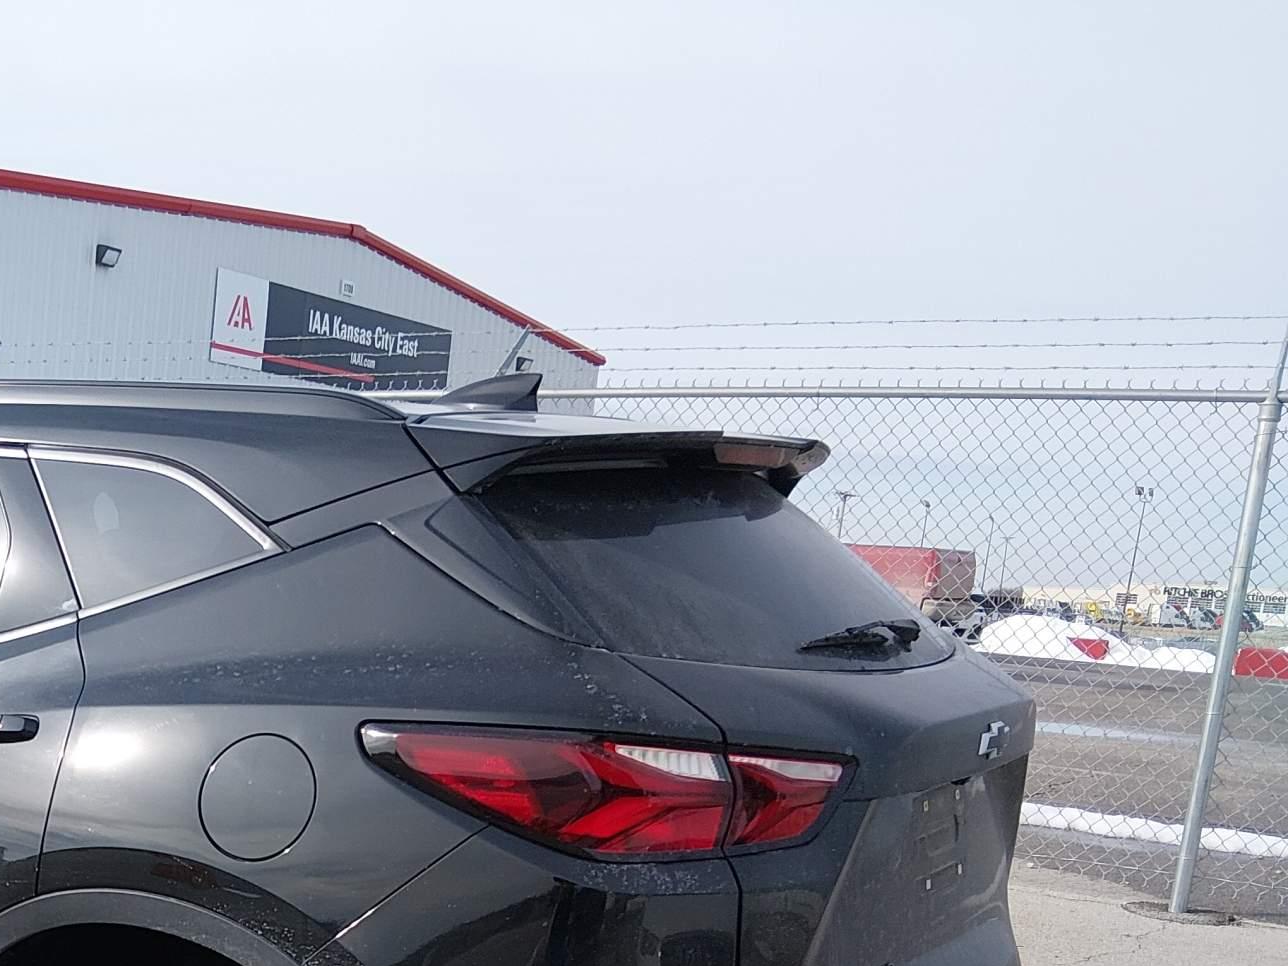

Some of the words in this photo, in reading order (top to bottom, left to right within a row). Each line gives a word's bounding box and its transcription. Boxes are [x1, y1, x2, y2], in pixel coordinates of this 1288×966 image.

[308, 309, 330, 337] IAA
[332, 315, 373, 347] Kansas
[374, 326, 396, 357] City
[396, 331, 419, 358] East
